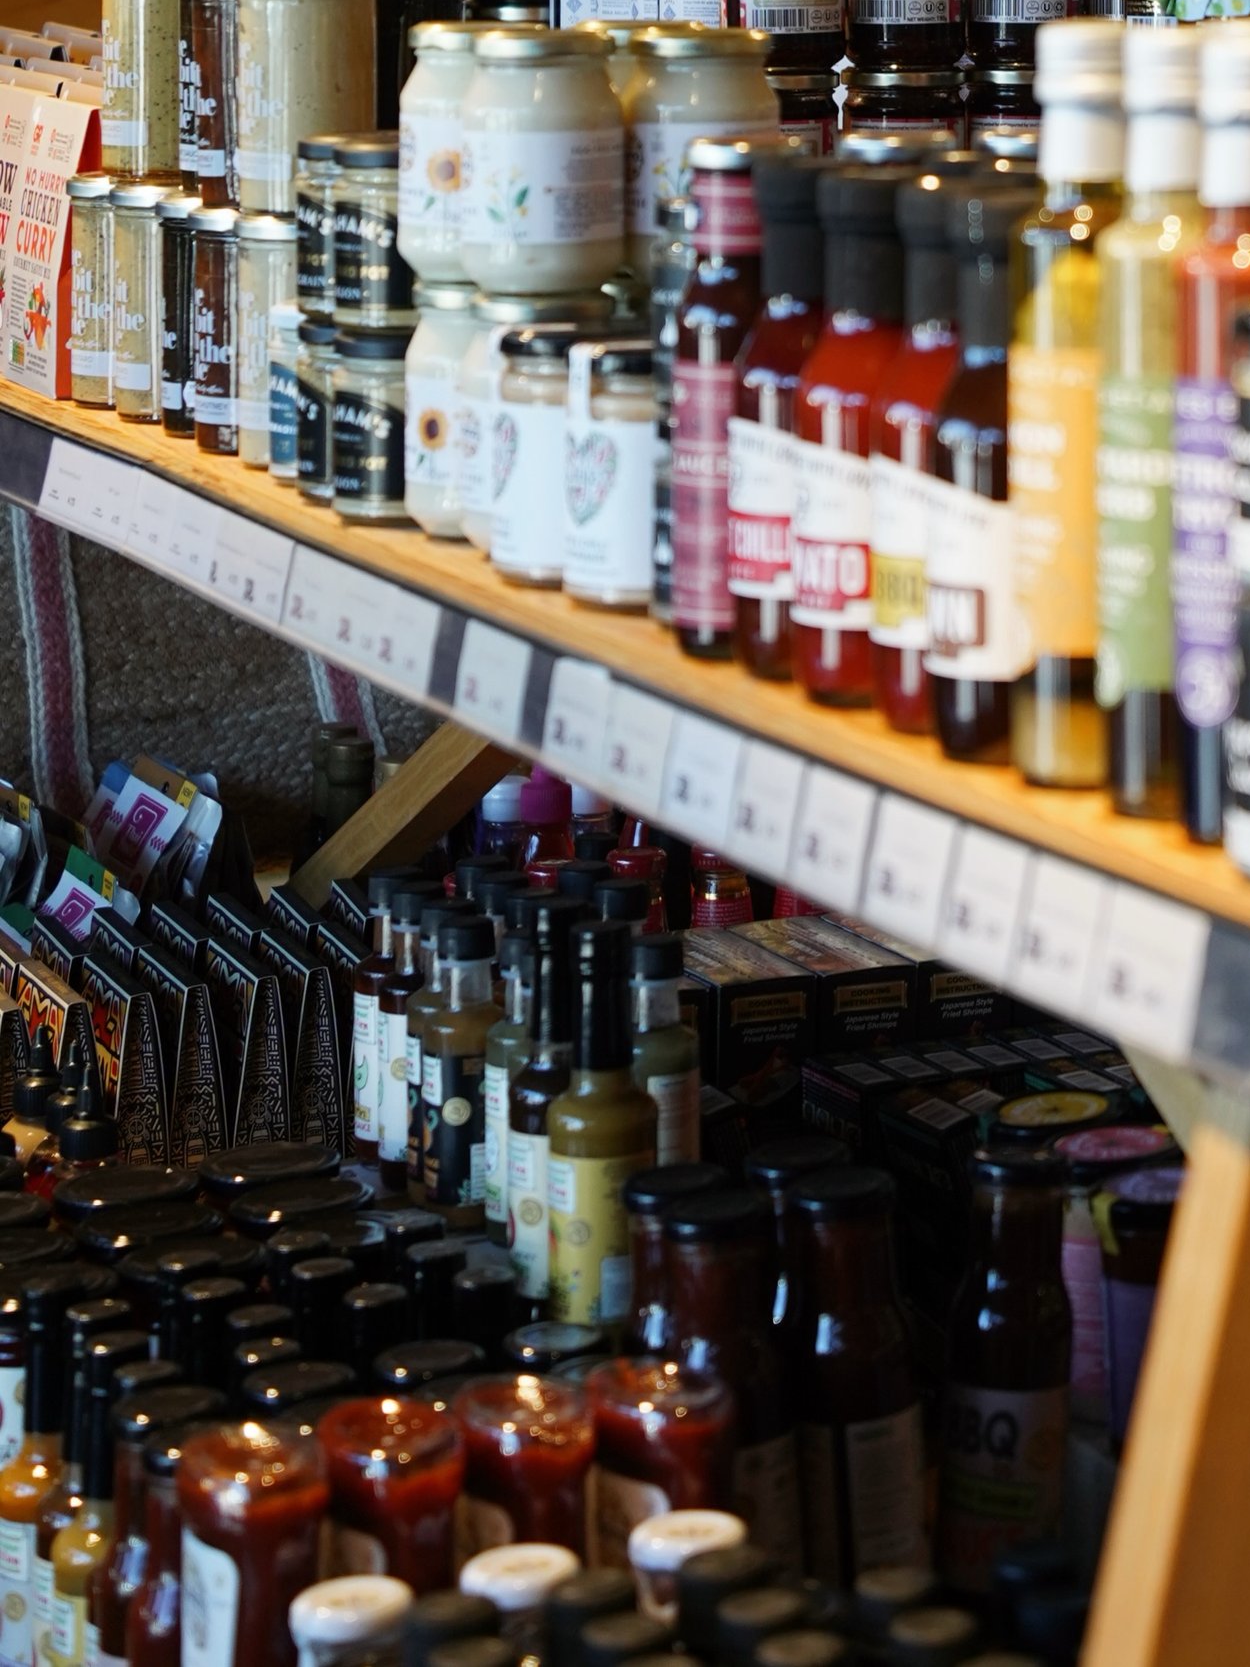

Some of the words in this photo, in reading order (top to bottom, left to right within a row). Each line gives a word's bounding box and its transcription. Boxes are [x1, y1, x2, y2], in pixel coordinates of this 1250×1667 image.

[24, 166, 37, 186] NO
[38, 171, 67, 196] HURRY
[20, 188, 62, 228] CHICKEN
[16, 219, 57, 265] CURRY
[200, 335, 232, 364] the
[850, 986, 891, 998] COOKING
[748, 996, 790, 1009] COOKING
[940, 998, 976, 1012] Japanese
[976, 997, 994, 1008] Style
[843, 1012, 879, 1026] Japanese
[880, 1010, 900, 1022] Style
[942, 1008, 961, 1019] Fried
[742, 1023, 778, 1038] Japanese
[778, 1021, 799, 1033] Style
[845, 1021, 867, 1033] Fried
[743, 1033, 765, 1045] Fried
